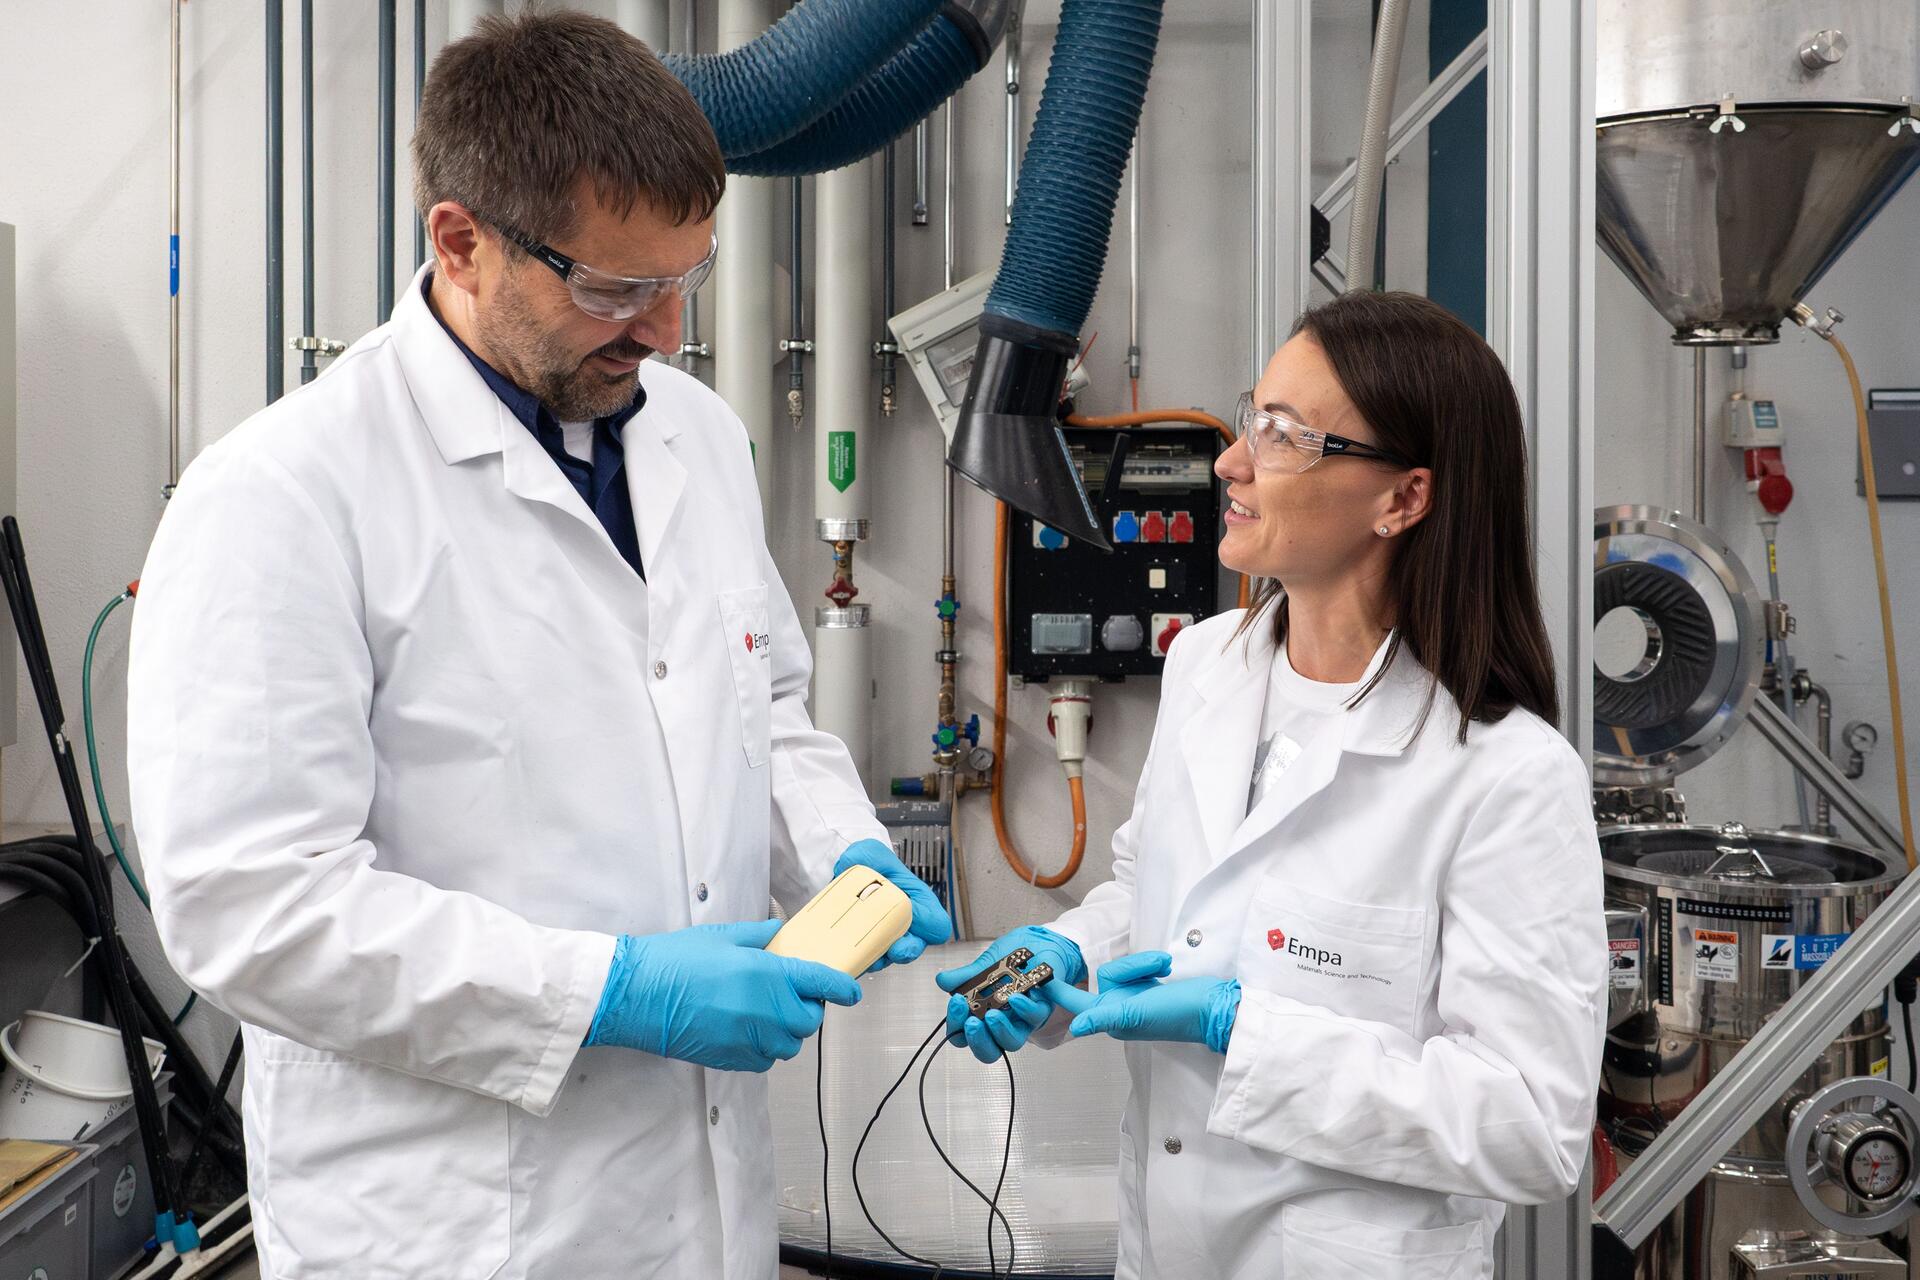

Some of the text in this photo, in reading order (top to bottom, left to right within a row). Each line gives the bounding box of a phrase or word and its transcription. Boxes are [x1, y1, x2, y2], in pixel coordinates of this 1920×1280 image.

[1288, 937, 1342, 967] Empa
[1613, 941, 1638, 949] DANGER
[1297, 963, 1323, 976] Materials
[1324, 969, 1346, 980] Science
[1360, 973, 1392, 986] Technology
